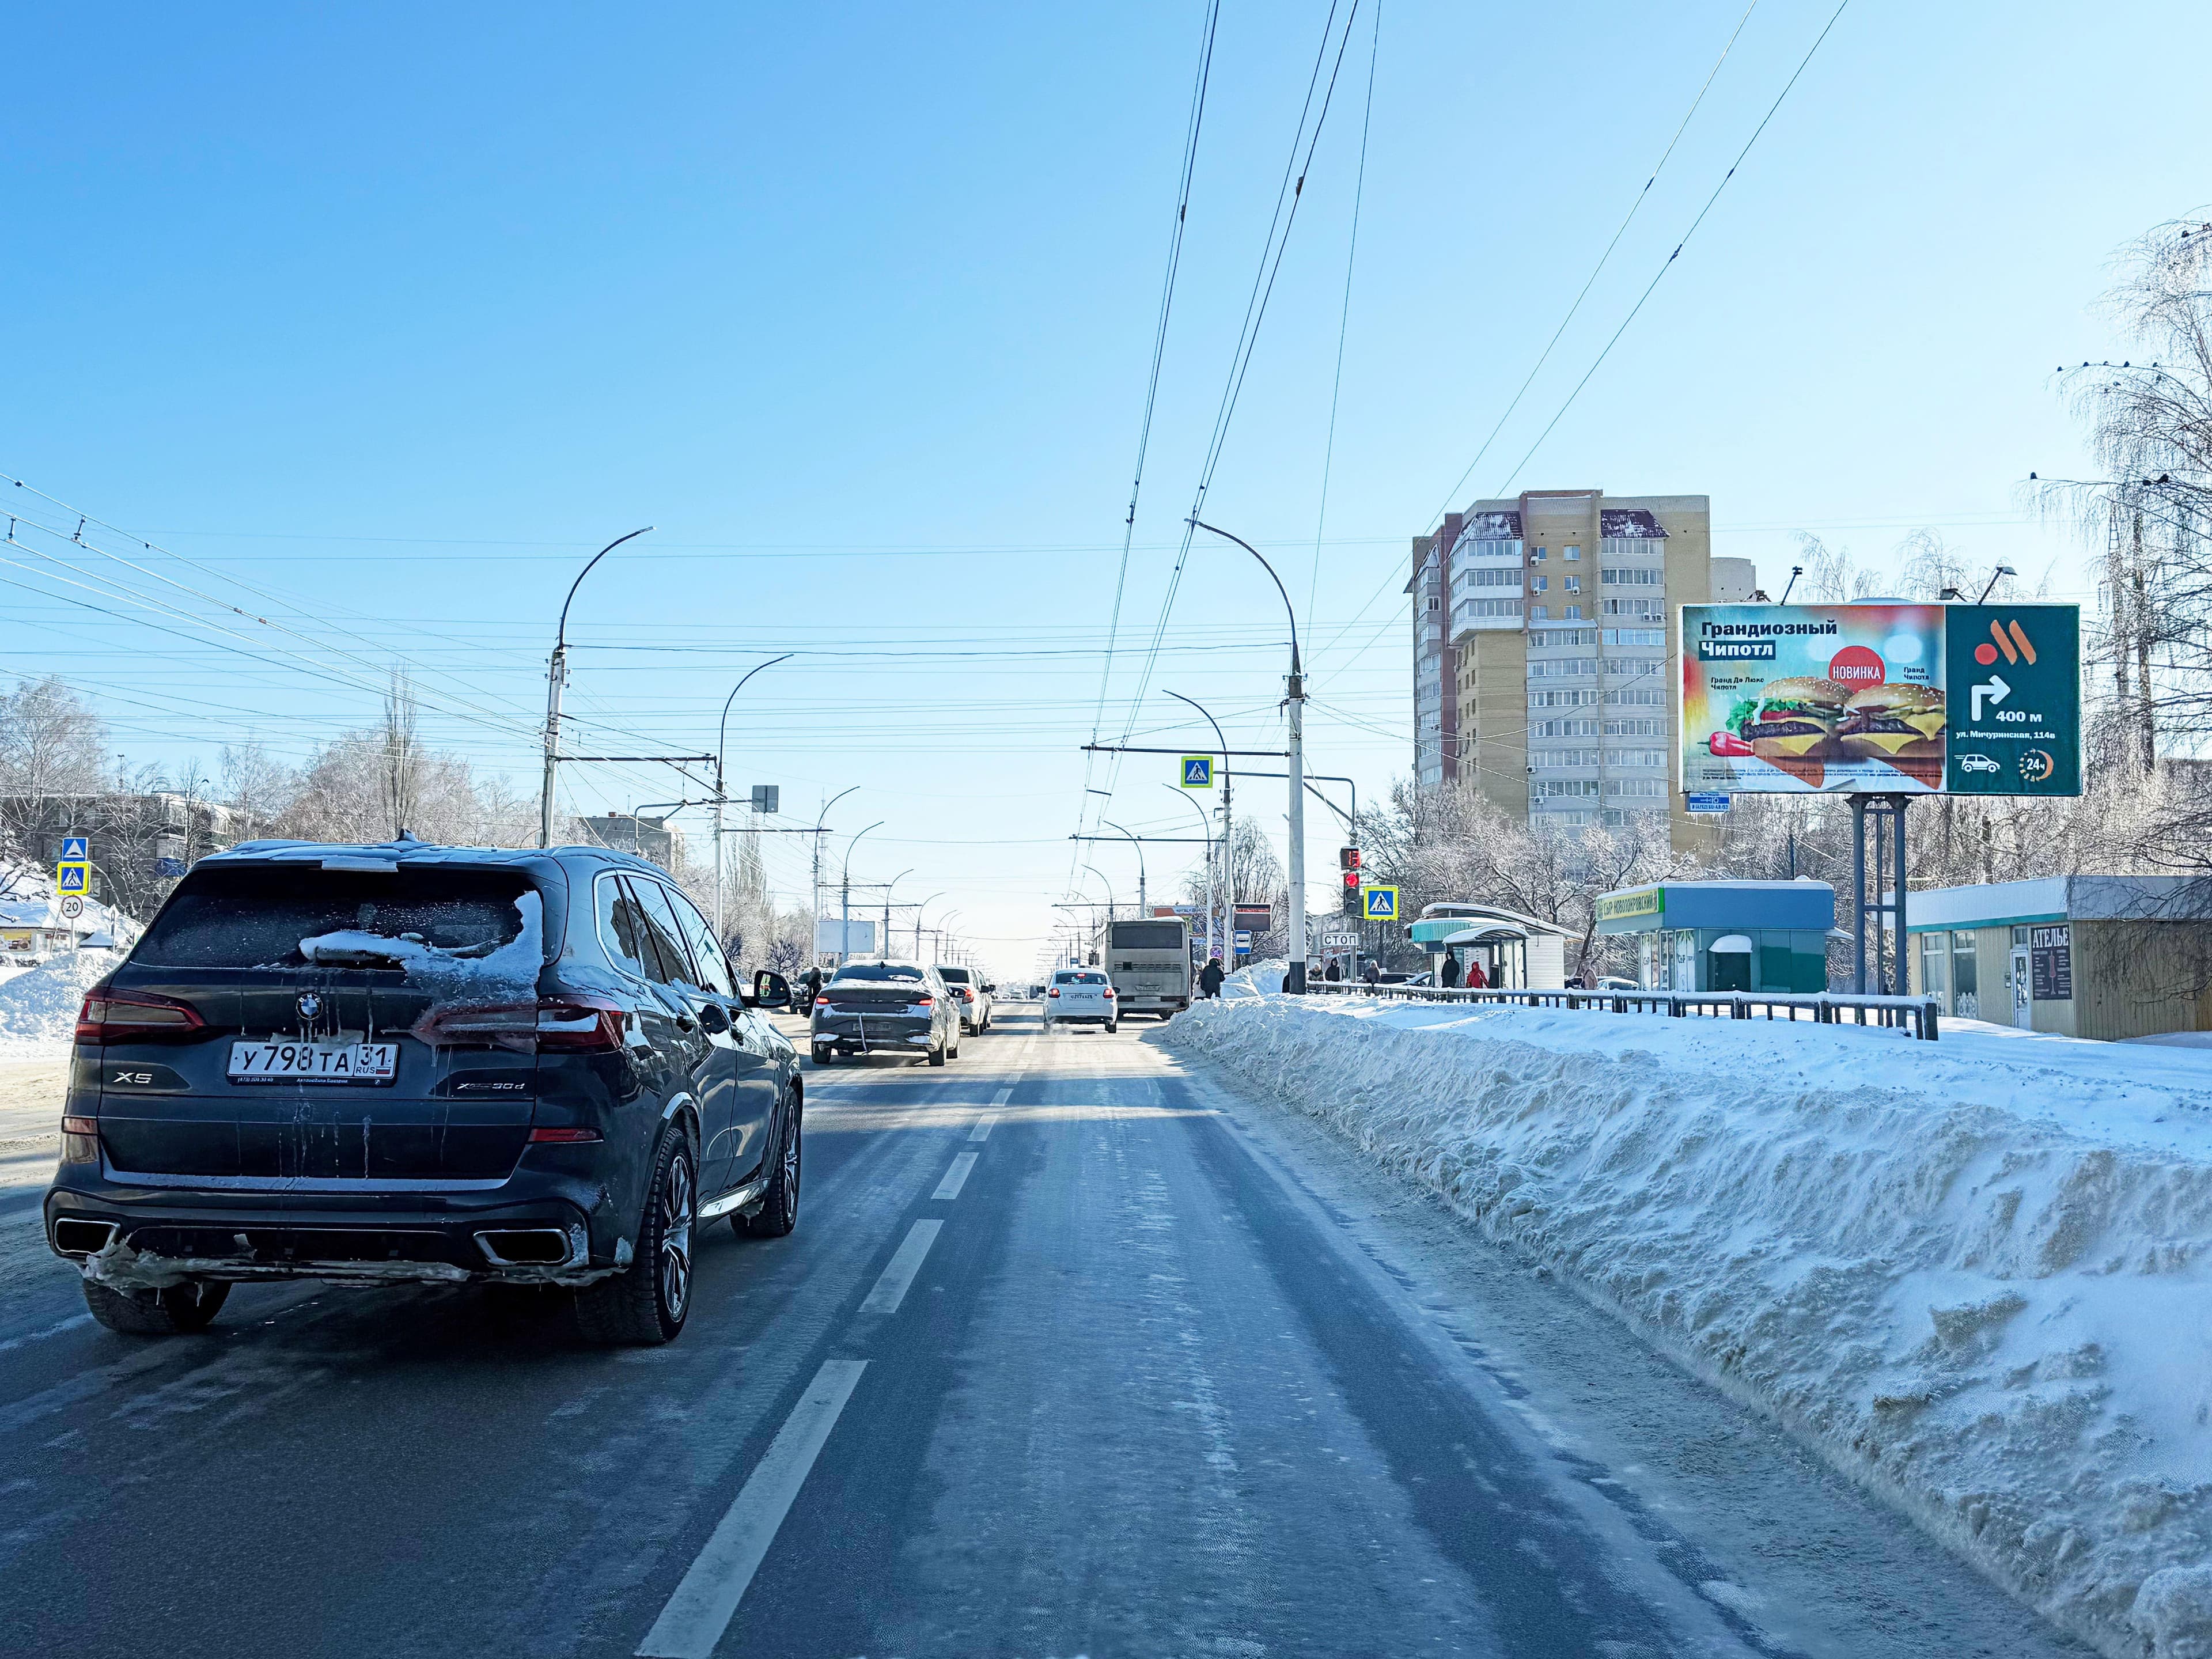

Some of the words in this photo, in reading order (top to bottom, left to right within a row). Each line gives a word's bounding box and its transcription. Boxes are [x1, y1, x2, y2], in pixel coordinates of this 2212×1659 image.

[1702, 619, 1838, 638] Грандиозный
[1701, 641, 1774, 656] Чипотл
[1832, 666, 1881, 680] НОВИНКА
[1995, 710, 2026, 722] 400
[2029, 714, 2042, 722] м
[1969, 730, 2032, 740] Мичуринская,
[66, 902, 79, 912] 20
[1603, 901, 1613, 915] СЫР
[1325, 935, 1357, 945] СТОП
[2032, 926, 2069, 948] АТЕЛЬЕ
[360, 1046, 387, 1066] 31
[112, 1072, 153, 1084] X5
